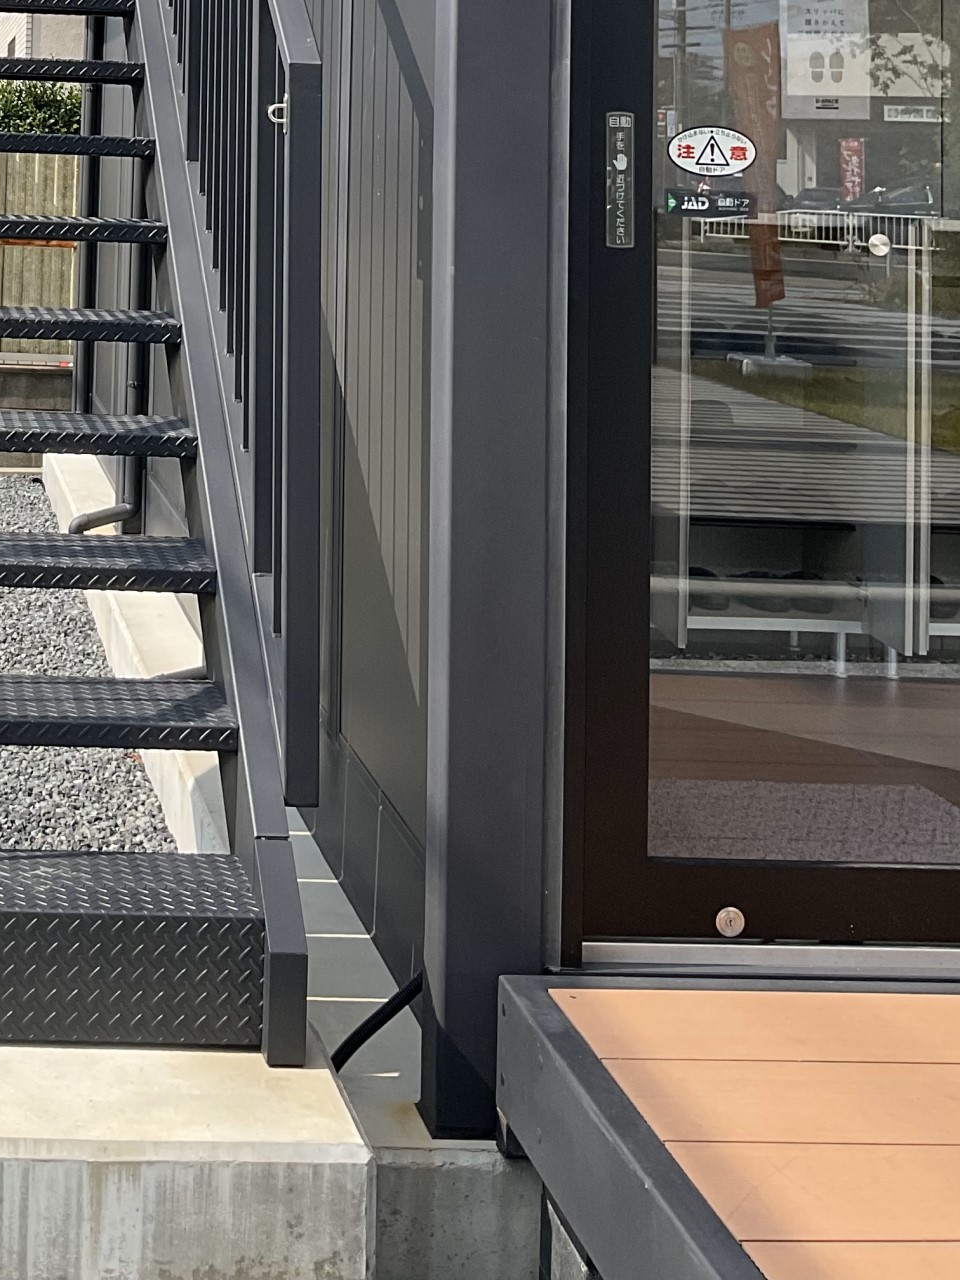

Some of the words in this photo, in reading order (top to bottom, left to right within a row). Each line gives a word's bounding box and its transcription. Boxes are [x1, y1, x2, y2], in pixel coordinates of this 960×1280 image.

[609, 116, 632, 127] 自動
[677, 144, 696, 159] 注
[729, 145, 748, 161] 意
[698, 166, 726, 174] 自動ドア
[681, 196, 710, 210] JAD
[717, 197, 750, 208] 自動ドア
